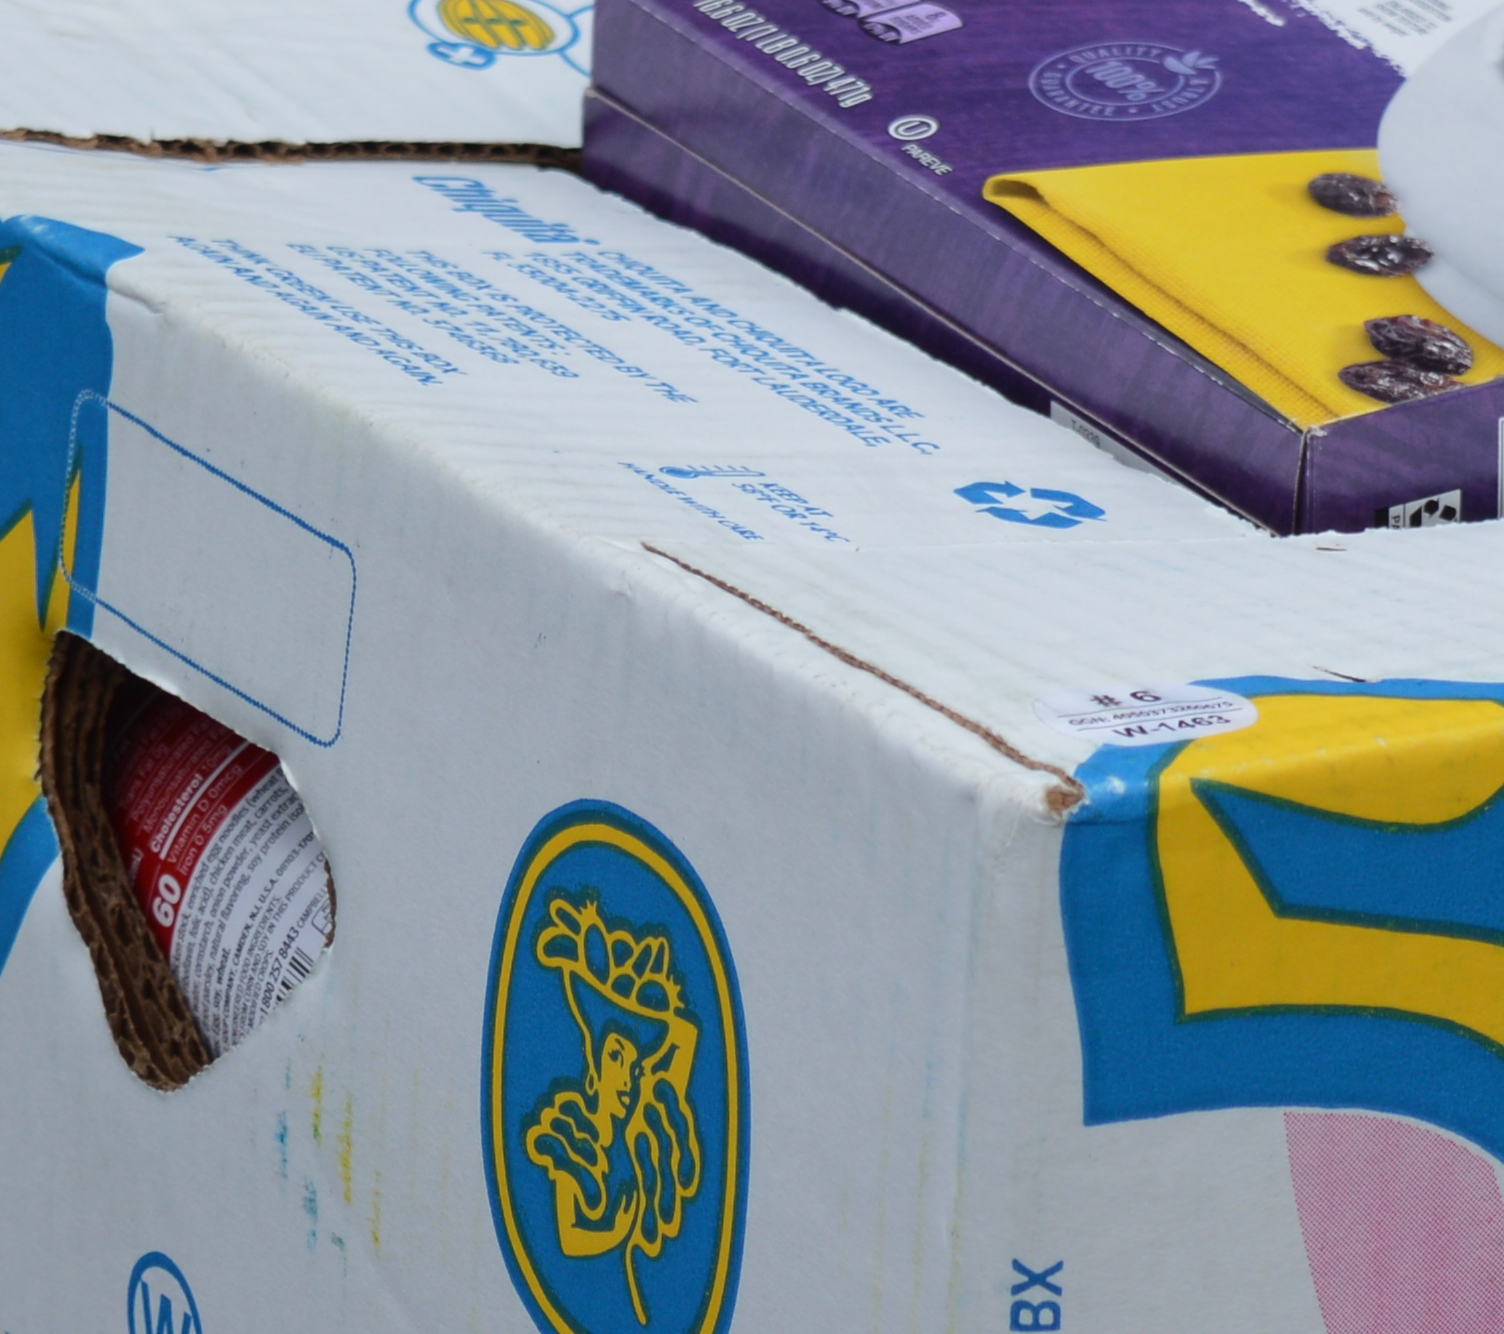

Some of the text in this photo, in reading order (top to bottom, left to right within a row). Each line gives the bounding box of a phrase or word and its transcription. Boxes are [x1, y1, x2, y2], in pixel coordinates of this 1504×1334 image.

[721, 12, 766, 33] OZ
[754, 34, 800, 55] LB
[1068, 46, 1163, 64] QUALITY
[1084, 60, 1166, 102] 100%
[901, 144, 953, 177] PAREVE
[413, 174, 581, 244] Chiquita
[312, 257, 403, 299] PATENT
[349, 259, 441, 300] PATENT
[363, 248, 481, 302] FOLLOWING
[323, 322, 381, 346] AND
[504, 303, 699, 403] PROTECTED BY THE
[559, 251, 894, 424] TRADEMARKS OF CHIQUITA BRANDS
[597, 251, 926, 418] CHIQUITA AND CHIQUITA LOGO ARE
[410, 352, 468, 376] BOX
[571, 276, 893, 448] GRIFFIN FORT LAUDERDALE,
[758, 482, 835, 518] KEEP AT
[717, 520, 765, 540] CARE
[1090, 690, 1163, 708] # 6
[1111, 714, 1232, 738] W-1463
[148, 772, 205, 853] Cholesterol
[167, 797, 212, 864] Vitamin D
[248, 816, 276, 849] yeast
[179, 802, 229, 877] Iron 5mg
[207, 814, 257, 888] chicken meat,
[246, 819, 289, 873] soy protein
[152, 872, 183, 929] 60
[232, 922, 253, 967] CAMDEN,
[261, 926, 301, 1010] 800 257 8443
